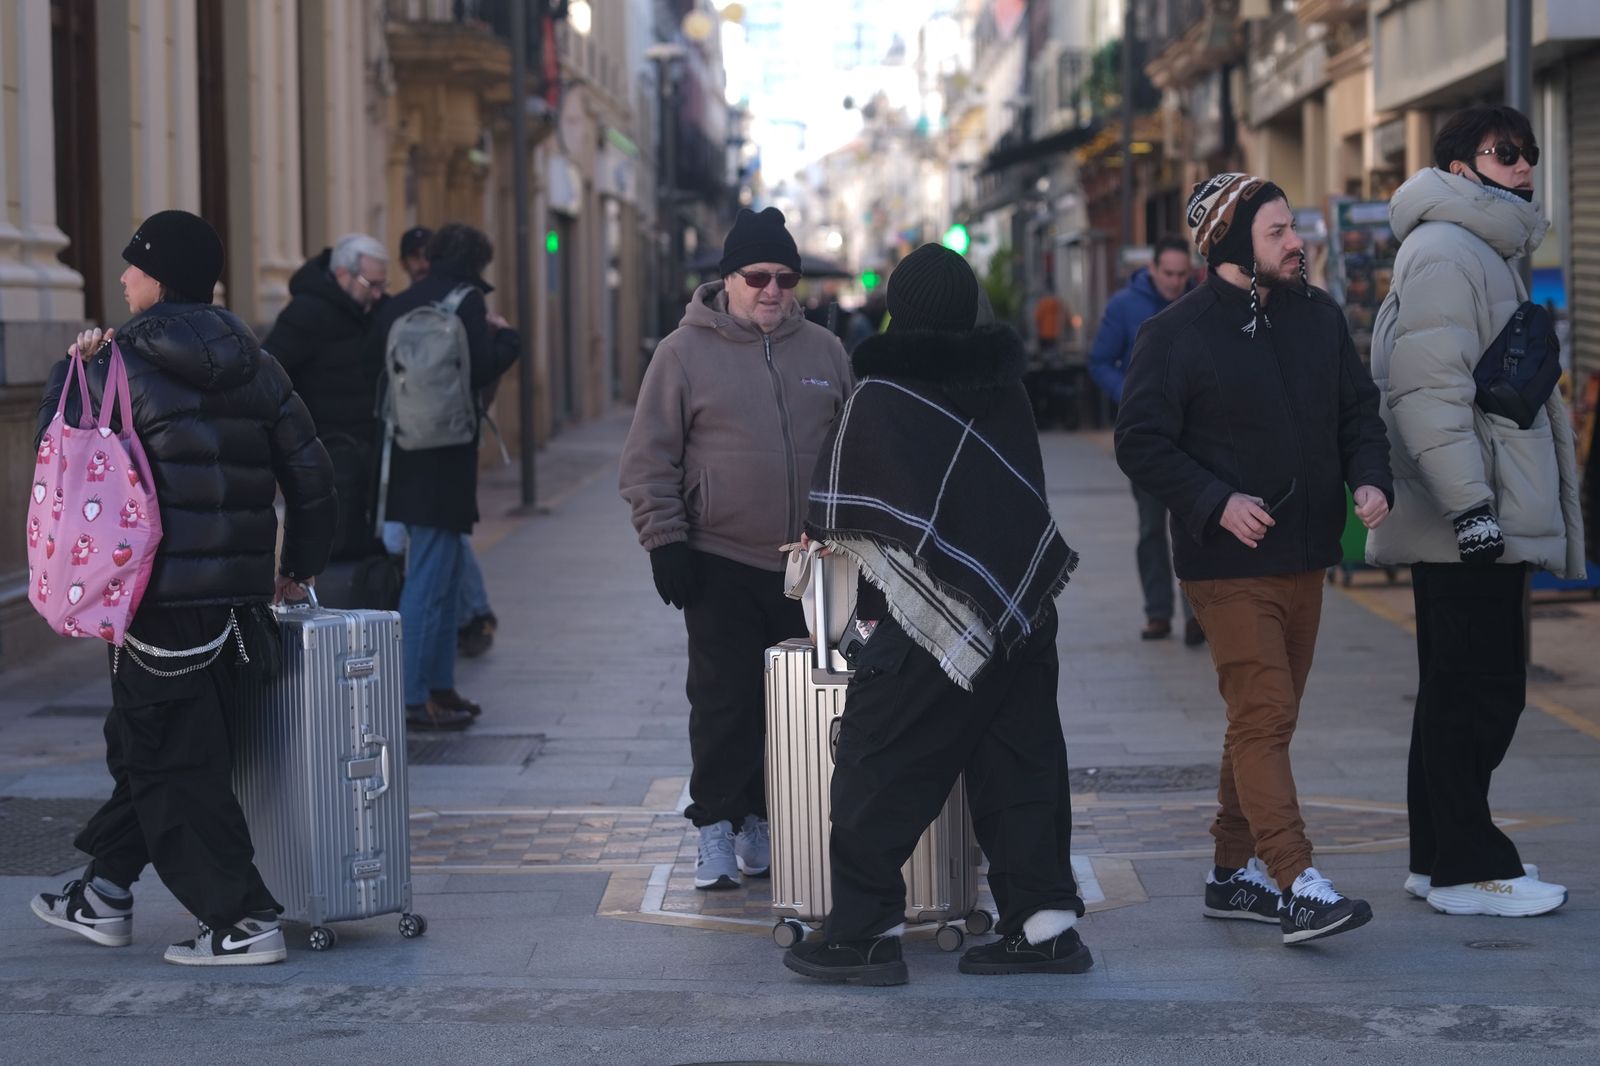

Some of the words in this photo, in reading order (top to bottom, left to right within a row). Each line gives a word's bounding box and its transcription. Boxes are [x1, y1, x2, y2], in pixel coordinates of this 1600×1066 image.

[1229, 888, 1257, 911] N
[1472, 881, 1513, 895] HOKA
[1295, 907, 1315, 930] N
